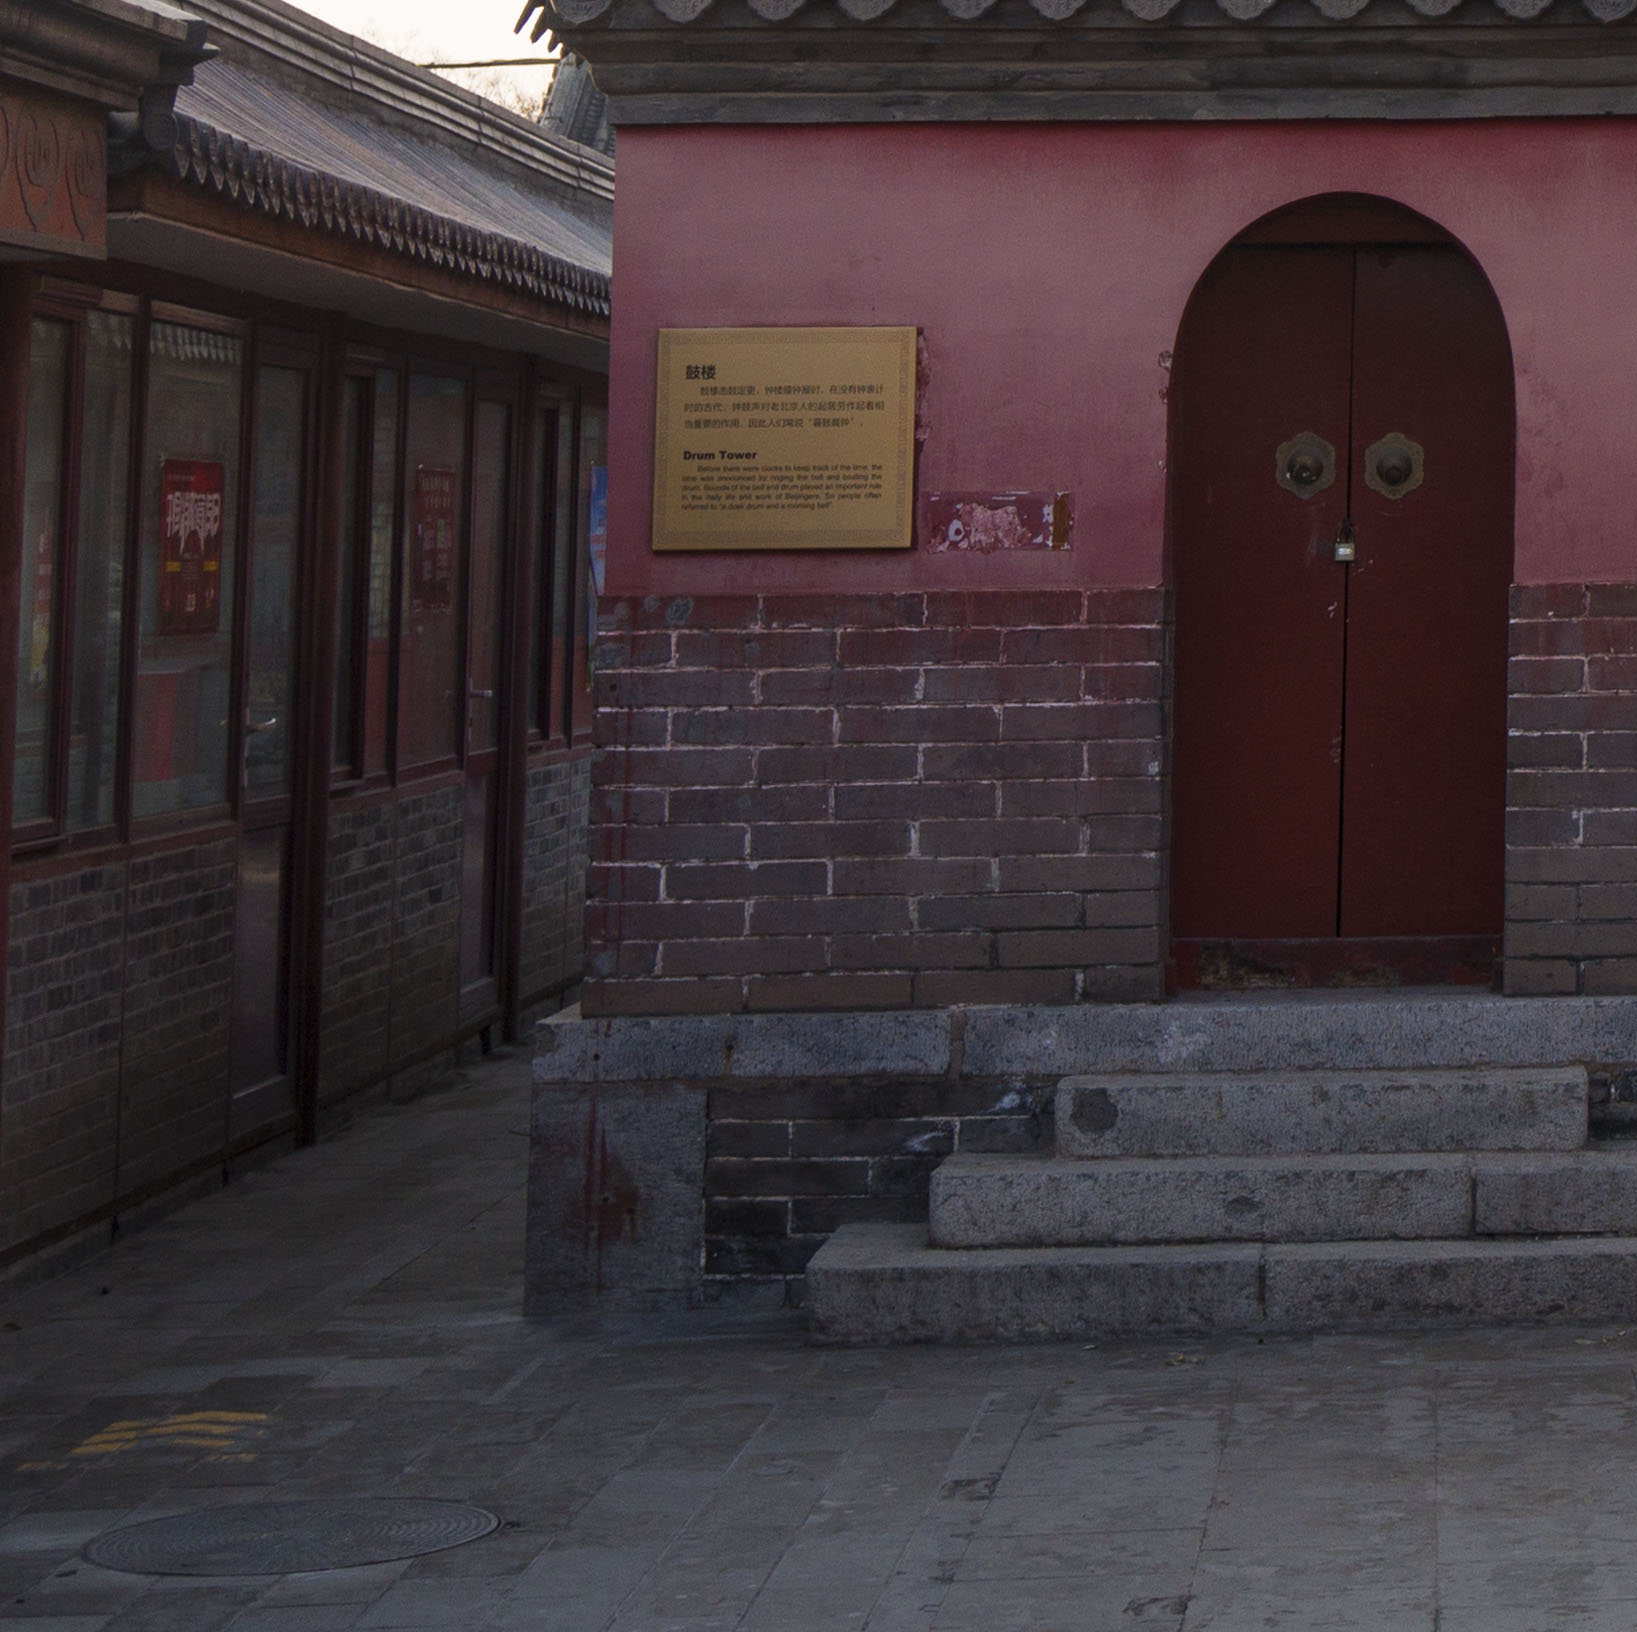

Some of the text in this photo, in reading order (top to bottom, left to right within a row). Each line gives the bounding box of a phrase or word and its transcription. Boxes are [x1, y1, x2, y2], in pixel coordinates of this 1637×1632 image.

[686, 364, 716, 380] 鼓楼
[683, 451, 757, 460] Drum Tower
[793, 464, 810, 472] keep
